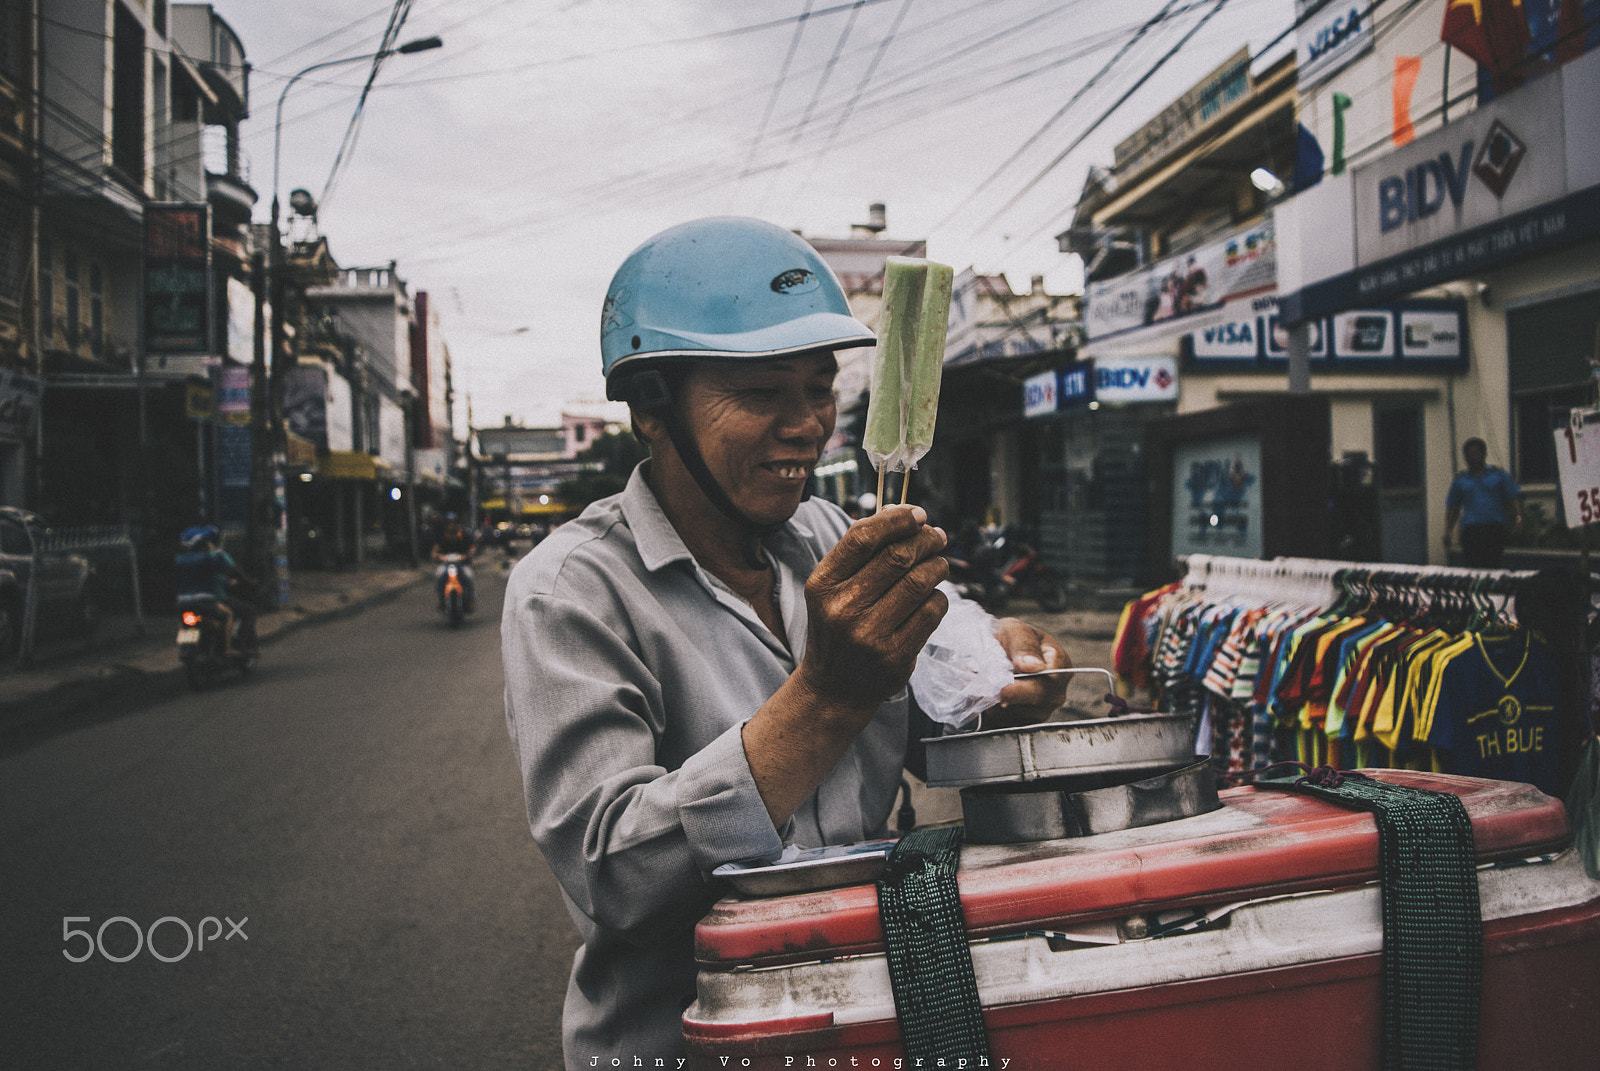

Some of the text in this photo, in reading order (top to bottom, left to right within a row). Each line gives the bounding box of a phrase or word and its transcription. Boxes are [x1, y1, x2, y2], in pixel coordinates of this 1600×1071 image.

[1308, 8, 1362, 61] VISA
[1379, 139, 1475, 233] BIDV
[1204, 322, 1253, 345] VISA
[1097, 366, 1150, 389] BIDV
